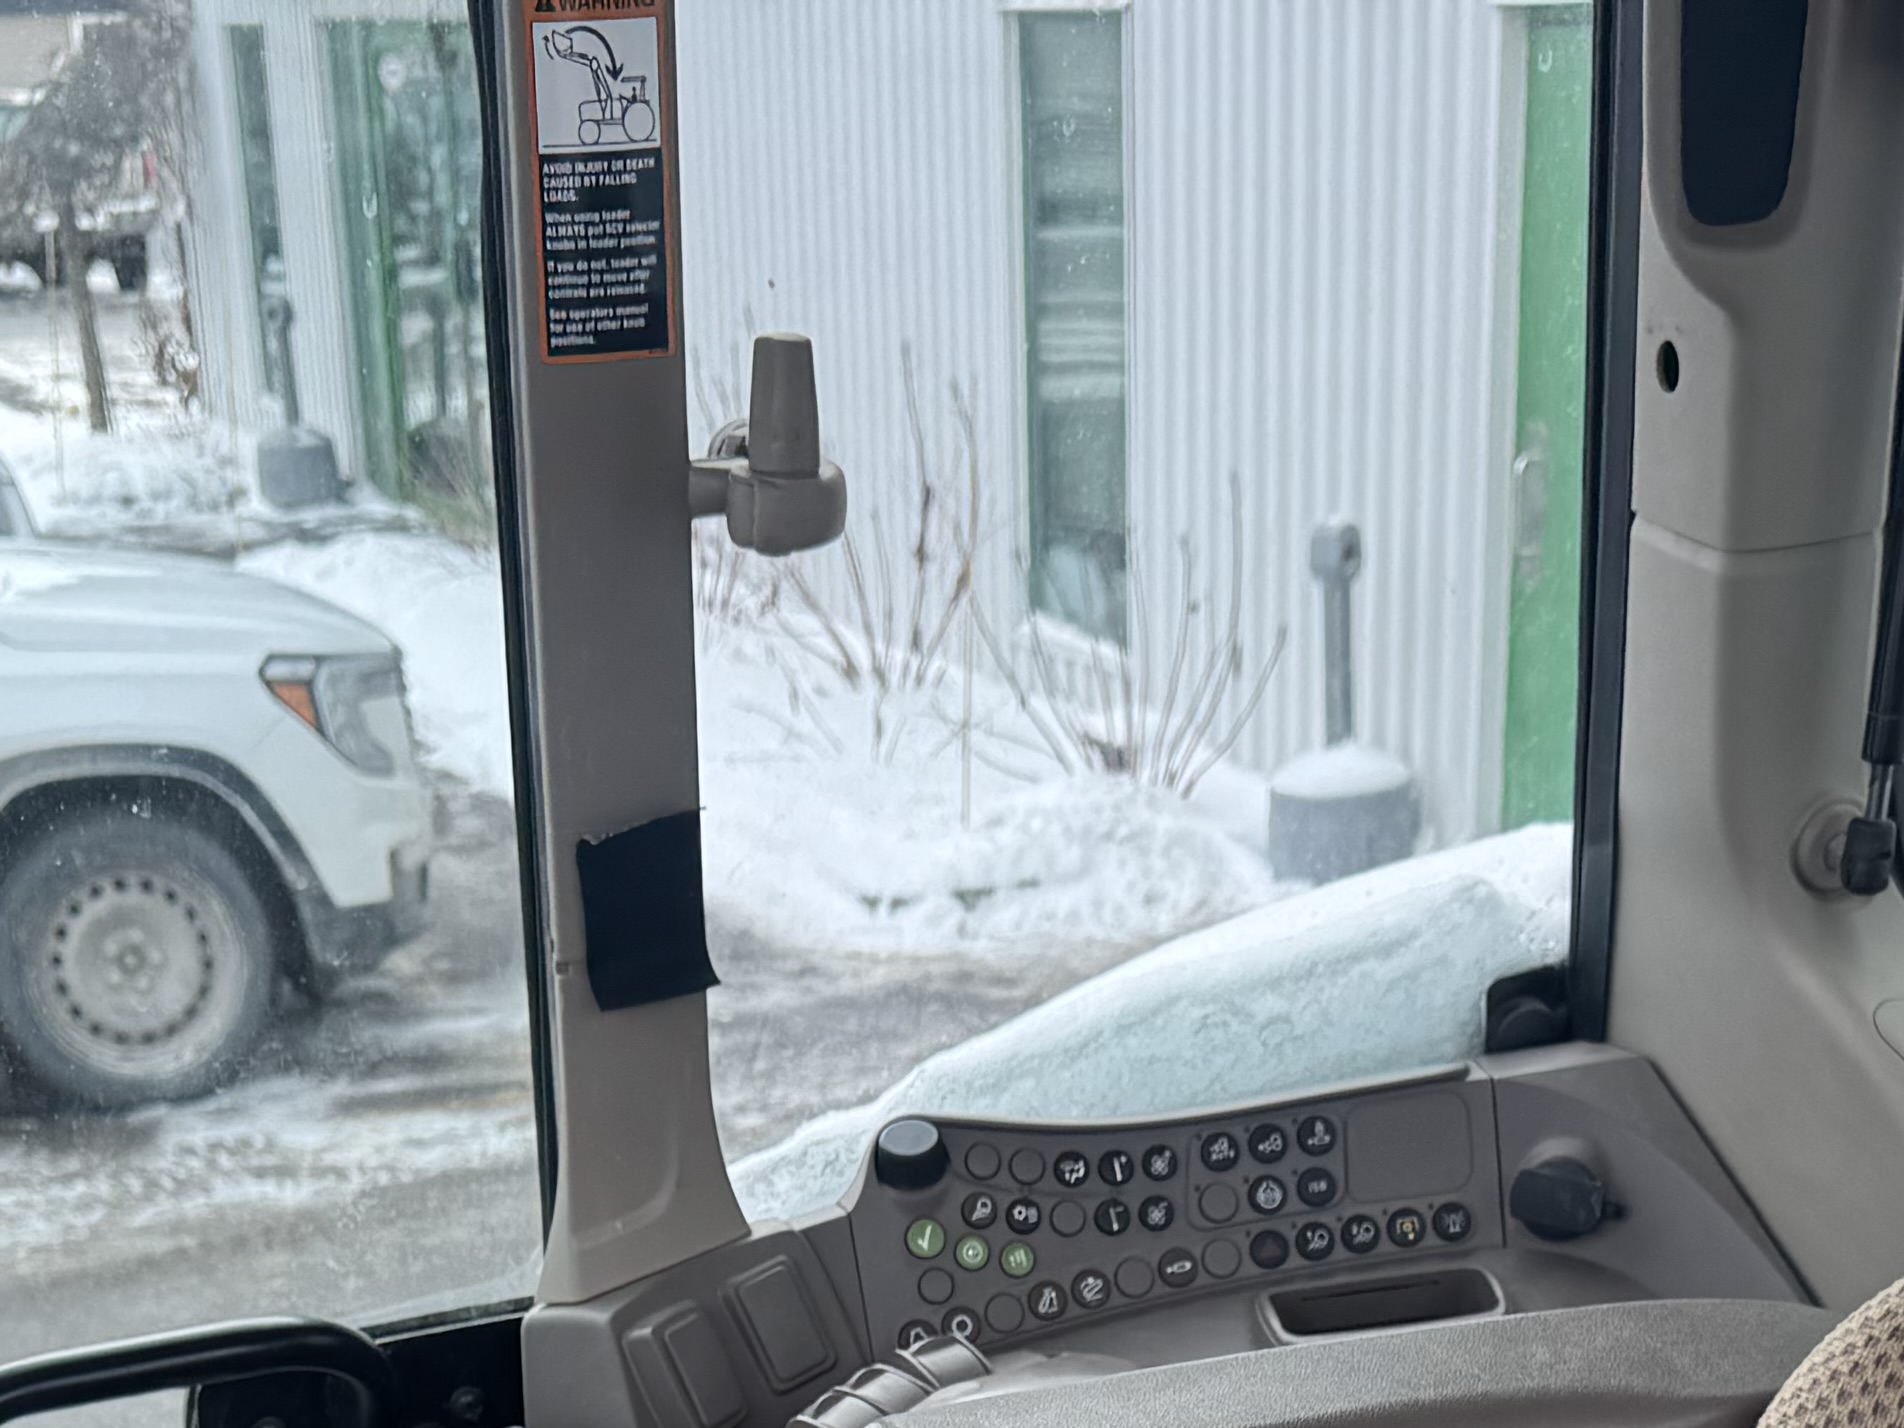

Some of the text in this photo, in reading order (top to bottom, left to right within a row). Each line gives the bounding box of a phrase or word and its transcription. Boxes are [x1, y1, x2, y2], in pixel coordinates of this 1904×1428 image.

[542, 157, 655, 174] AVOID INJURY OR DEATH
[543, 172, 637, 188] CAUSED BY FALLING
[543, 189, 579, 202] LOADS.
[545, 212, 572, 223] When
[546, 223, 585, 237] ALWAYS
